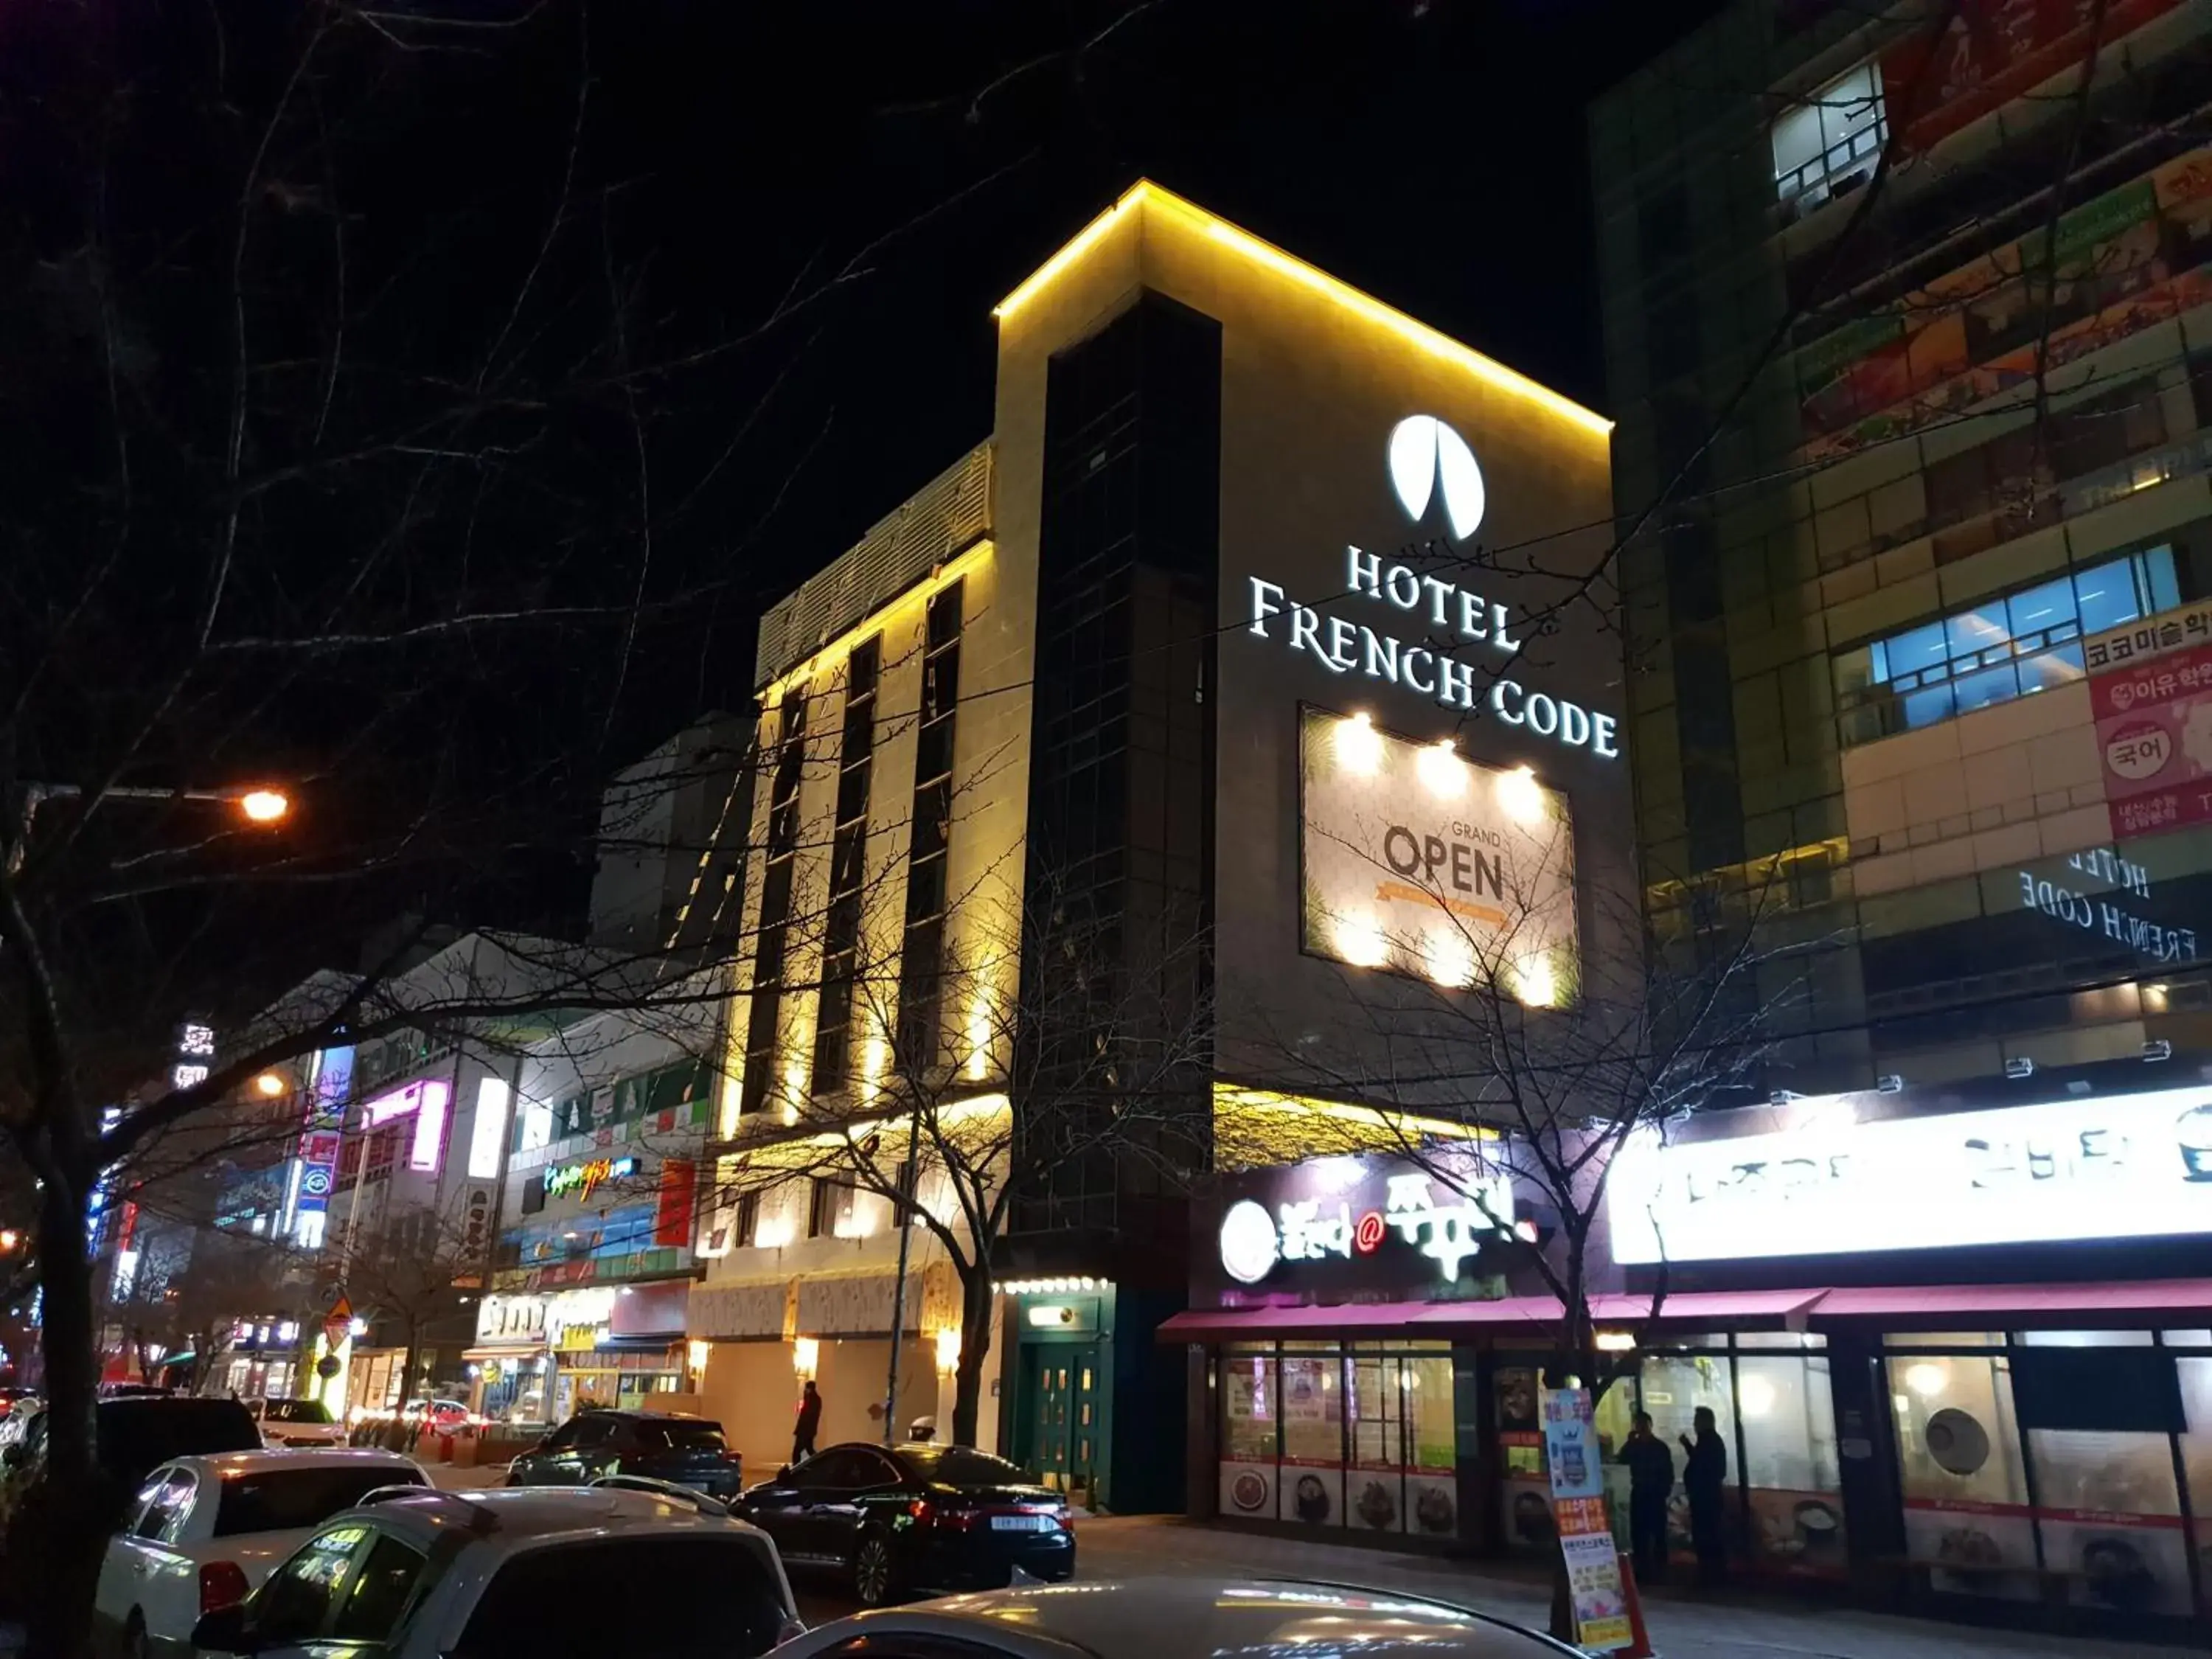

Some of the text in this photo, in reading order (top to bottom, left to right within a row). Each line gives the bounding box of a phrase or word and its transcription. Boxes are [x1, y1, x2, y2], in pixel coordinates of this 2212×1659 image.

[1347, 544, 1521, 653] HOTEL
[1248, 575, 1619, 760] FRENCH CODE
[2088, 610, 2212, 668] 코코미술학
[2114, 737, 2163, 766] 국어
[1384, 825, 1503, 901] OPEN
[1451, 821, 1500, 848] GRAND
